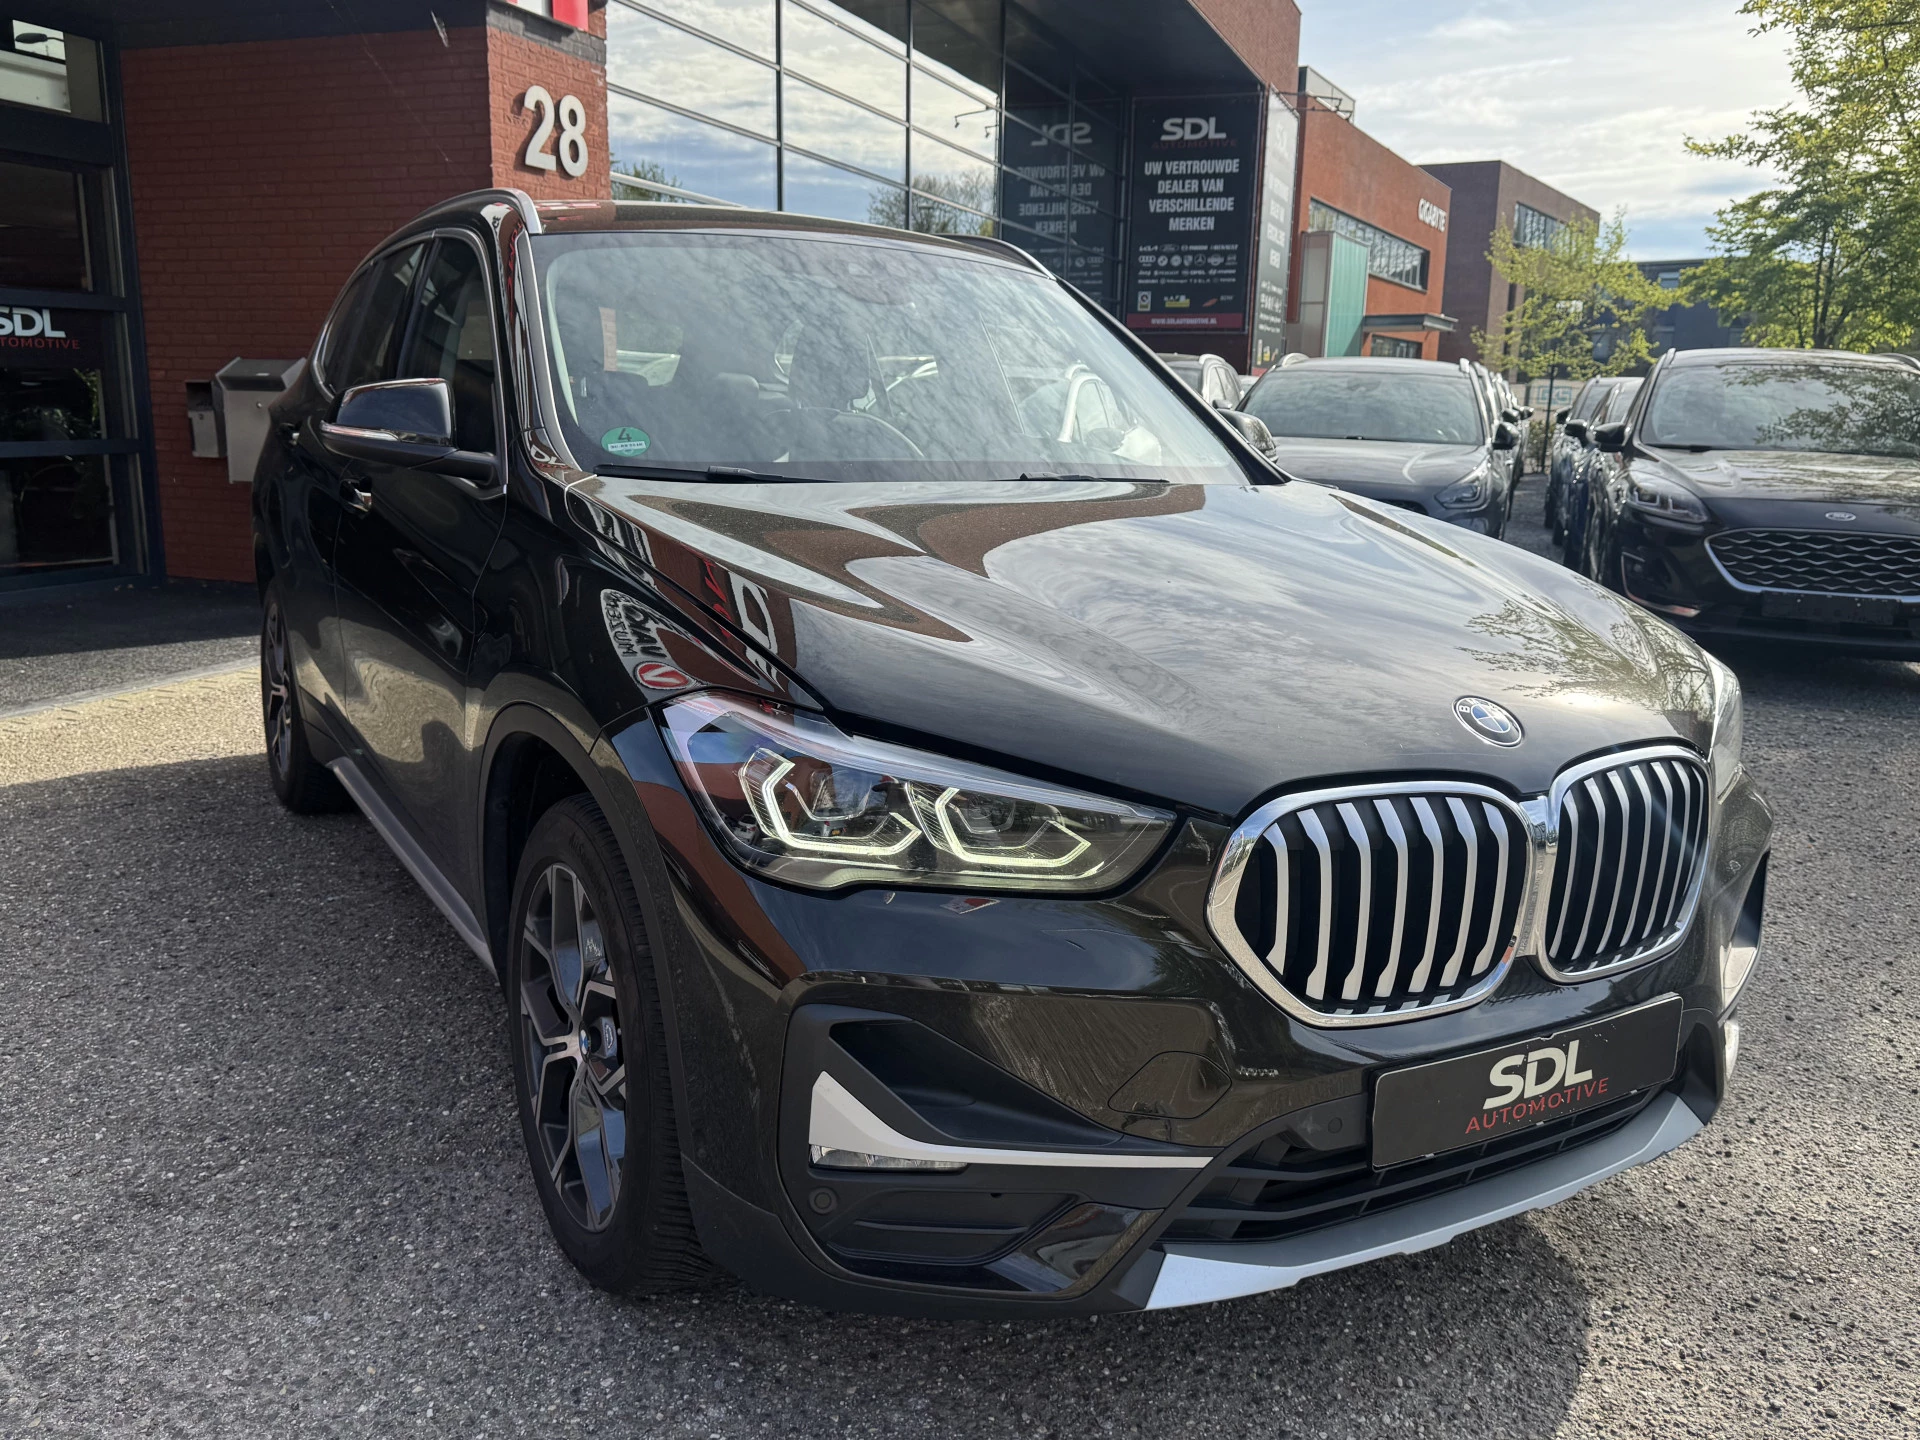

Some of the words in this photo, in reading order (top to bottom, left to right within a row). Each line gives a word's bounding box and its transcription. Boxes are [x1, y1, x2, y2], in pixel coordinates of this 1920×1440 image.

[523, 85, 589, 177] 28
[1160, 116, 1227, 141] SDL
[1151, 139, 1238, 150] AUTOMOTIVE
[1144, 161, 1163, 176] UW
[1165, 158, 1240, 175] VERTROUWDE
[1158, 179, 1199, 194] DEALER
[1201, 178, 1224, 193] VAN
[1149, 197, 1235, 213] VERSCHILLENDE
[1168, 216, 1215, 232] MERKEN
[618, 428, 632, 442] 4
[1482, 1039, 1593, 1110] SDL
[1465, 1077, 1609, 1134] AUTOMOTIVE
